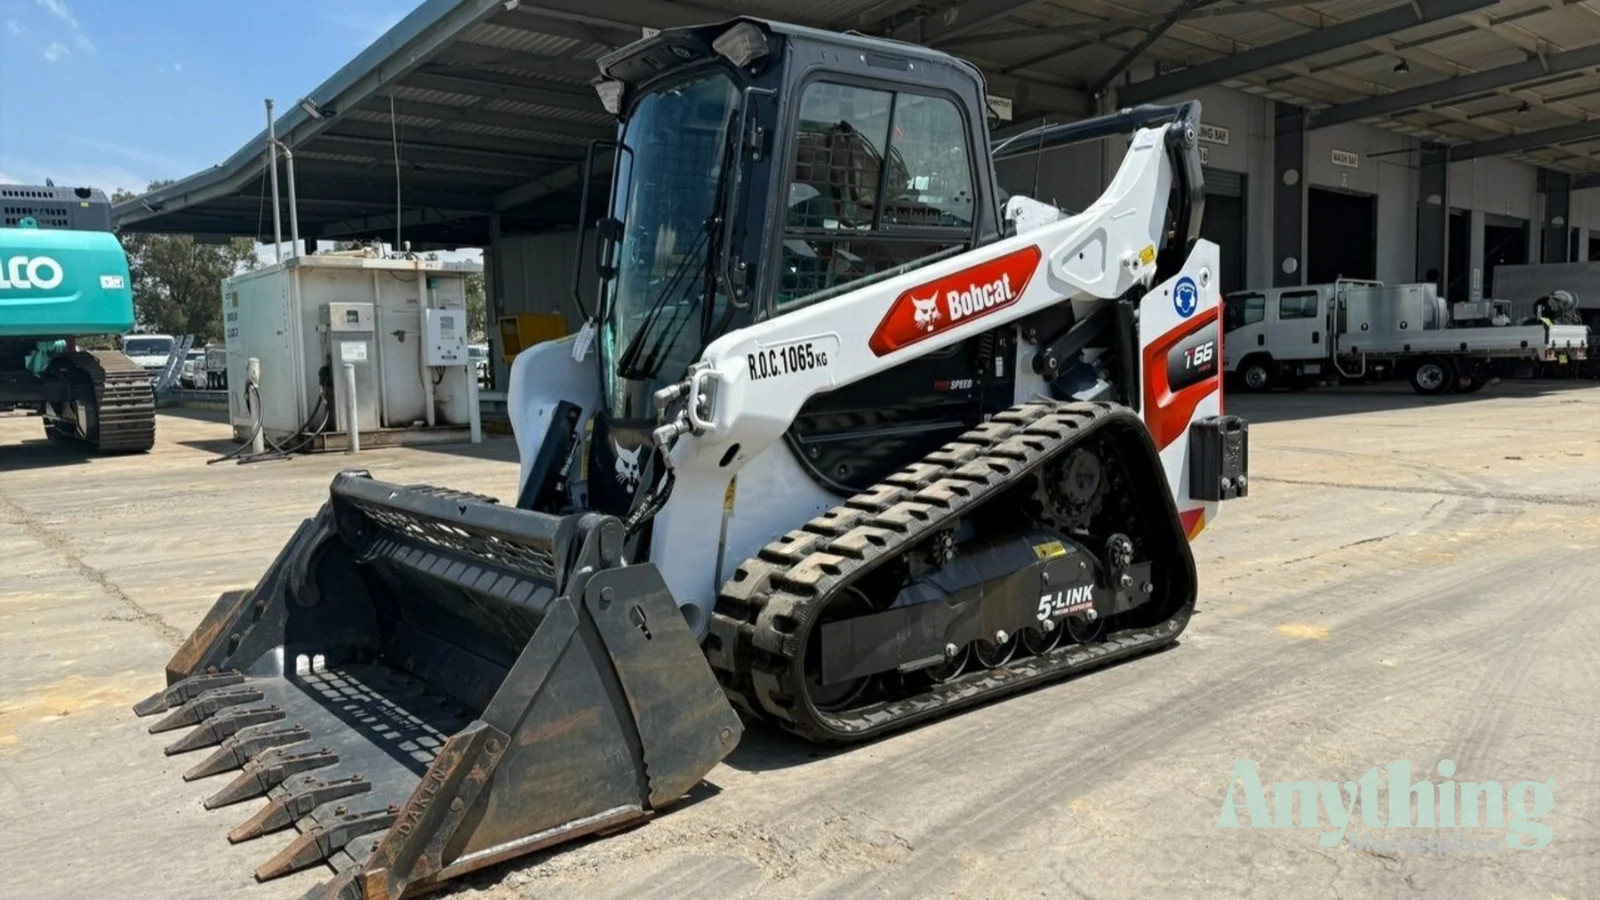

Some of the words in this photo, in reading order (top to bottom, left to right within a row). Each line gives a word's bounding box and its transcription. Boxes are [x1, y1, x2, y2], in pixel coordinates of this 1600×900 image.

[946, 272, 1013, 321] Bobcat
[1184, 341, 1214, 370] T66
[950, 379, 973, 390] SPEED
[1036, 584, 1094, 621] 5-LINK
[398, 769, 446, 837] DAKEN
